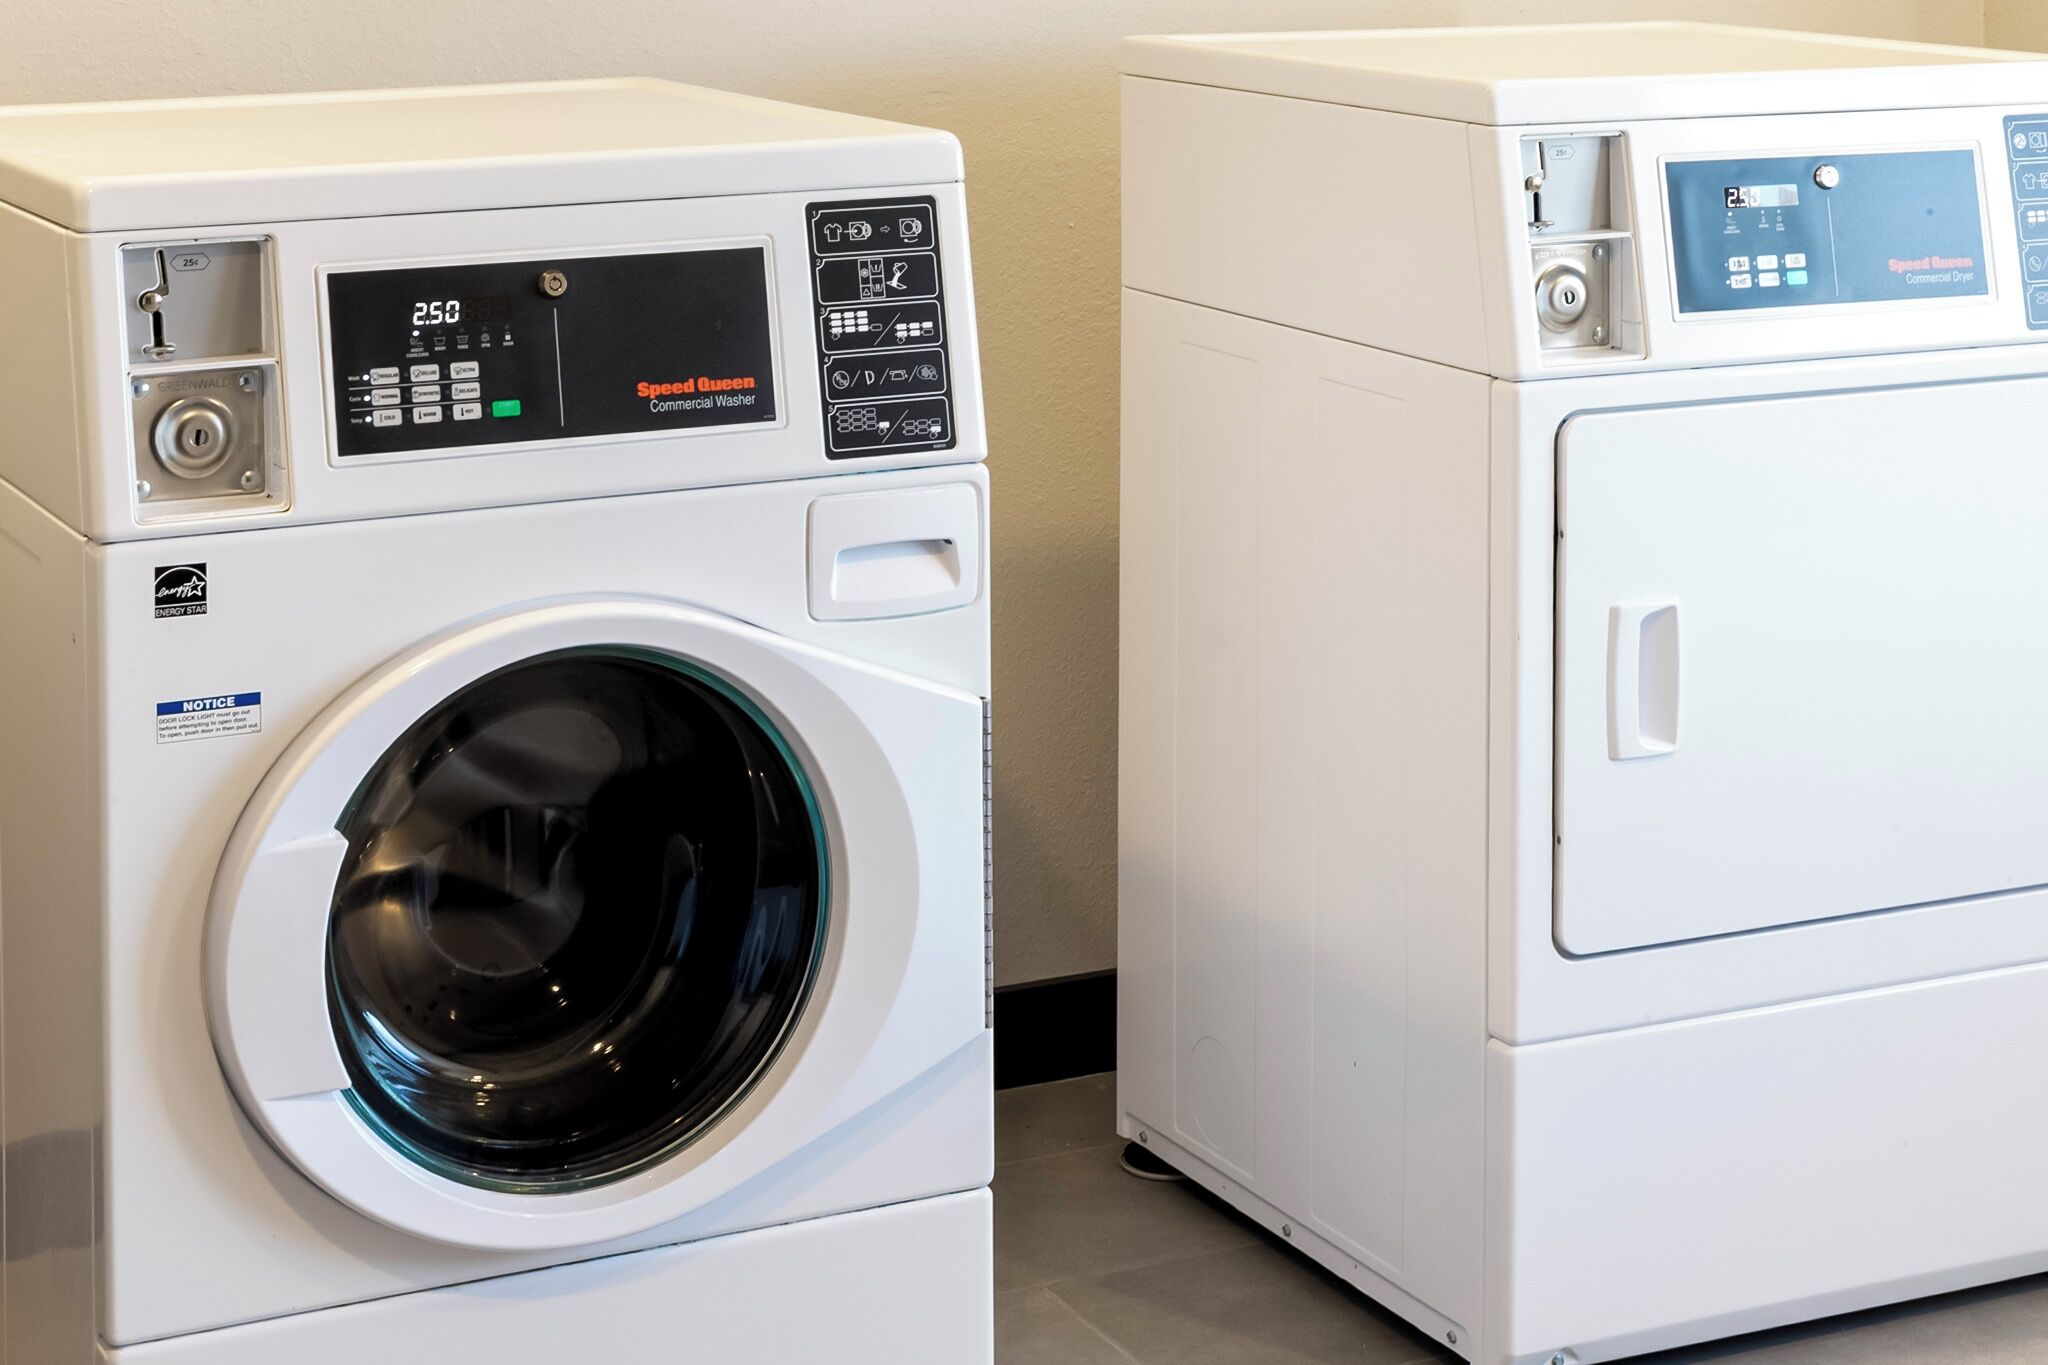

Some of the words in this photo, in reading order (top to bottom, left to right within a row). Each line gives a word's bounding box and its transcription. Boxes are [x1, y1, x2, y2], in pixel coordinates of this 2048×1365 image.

[183, 258, 199, 267] 25¢
[1888, 258, 1930, 273] Speed
[1931, 256, 1973, 268] Queen
[1906, 273, 1951, 284] Commercial
[1953, 271, 1974, 283] Dryer
[413, 300, 460, 325] 2.50
[158, 376, 230, 392] GREENWALD
[637, 378, 695, 398] Speed
[698, 376, 756, 392] Queen
[650, 396, 713, 412] Commercial
[716, 394, 756, 407] Washer
[155, 607, 186, 617] ENERGY
[186, 604, 207, 614] STAR
[183, 696, 236, 712] NOTICE
